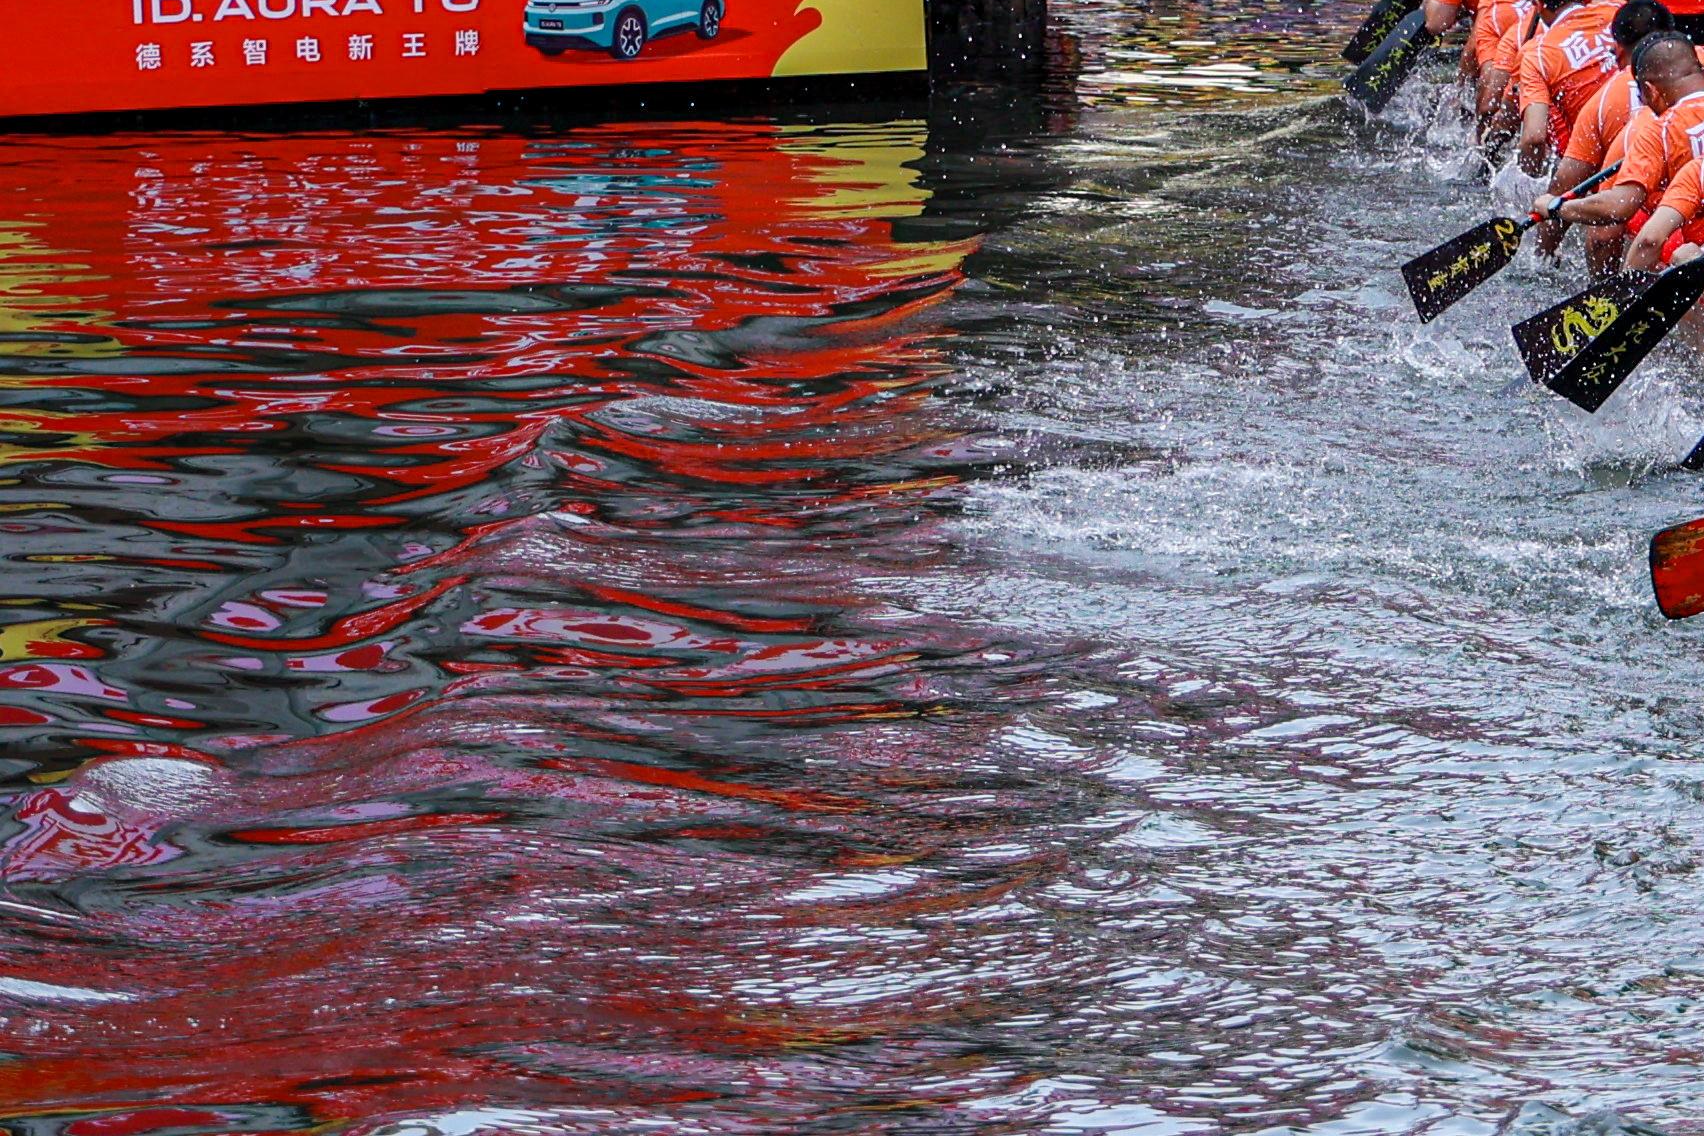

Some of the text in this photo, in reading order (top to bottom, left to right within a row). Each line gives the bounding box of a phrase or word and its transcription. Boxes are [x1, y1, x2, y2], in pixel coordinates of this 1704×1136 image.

[135, 28, 480, 71] 德系智电新王牌
